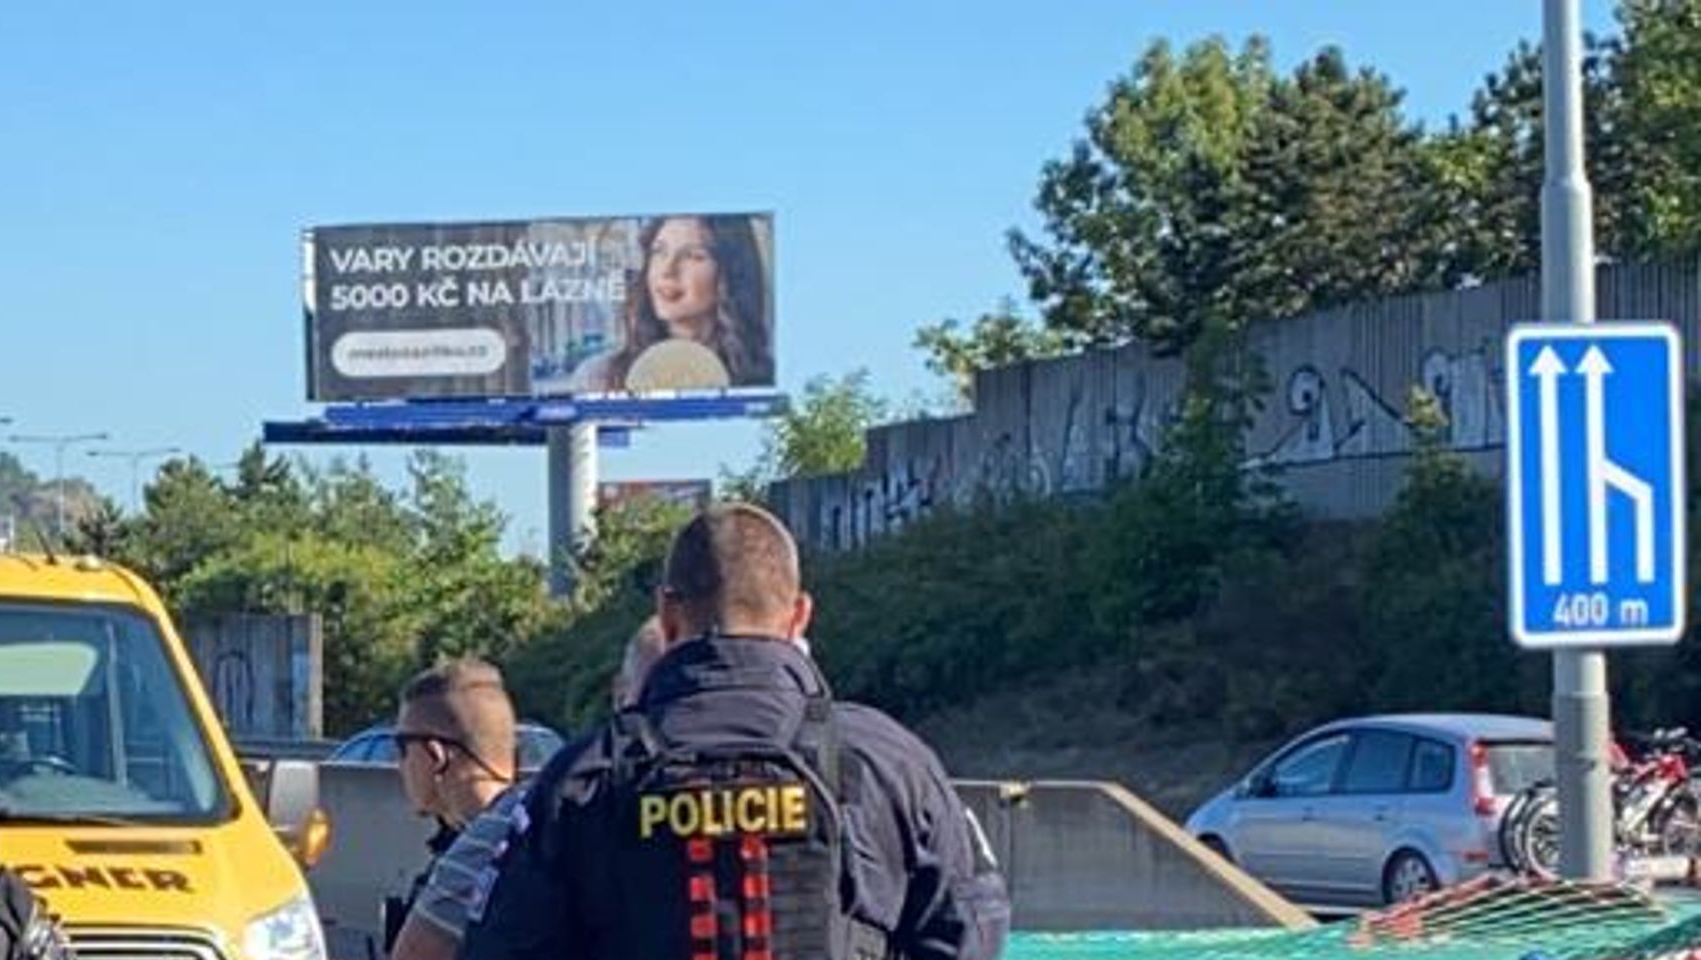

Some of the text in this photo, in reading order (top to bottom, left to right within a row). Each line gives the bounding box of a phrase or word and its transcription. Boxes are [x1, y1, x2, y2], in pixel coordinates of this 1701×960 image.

[329, 246, 414, 273] VARY
[330, 283, 410, 310] 5000
[417, 276, 459, 307] KČ
[467, 281, 513, 306] NA
[1552, 592, 1649, 627] 400 m
[638, 786, 806, 838] POLICIE
[15, 865, 194, 893] GNER
